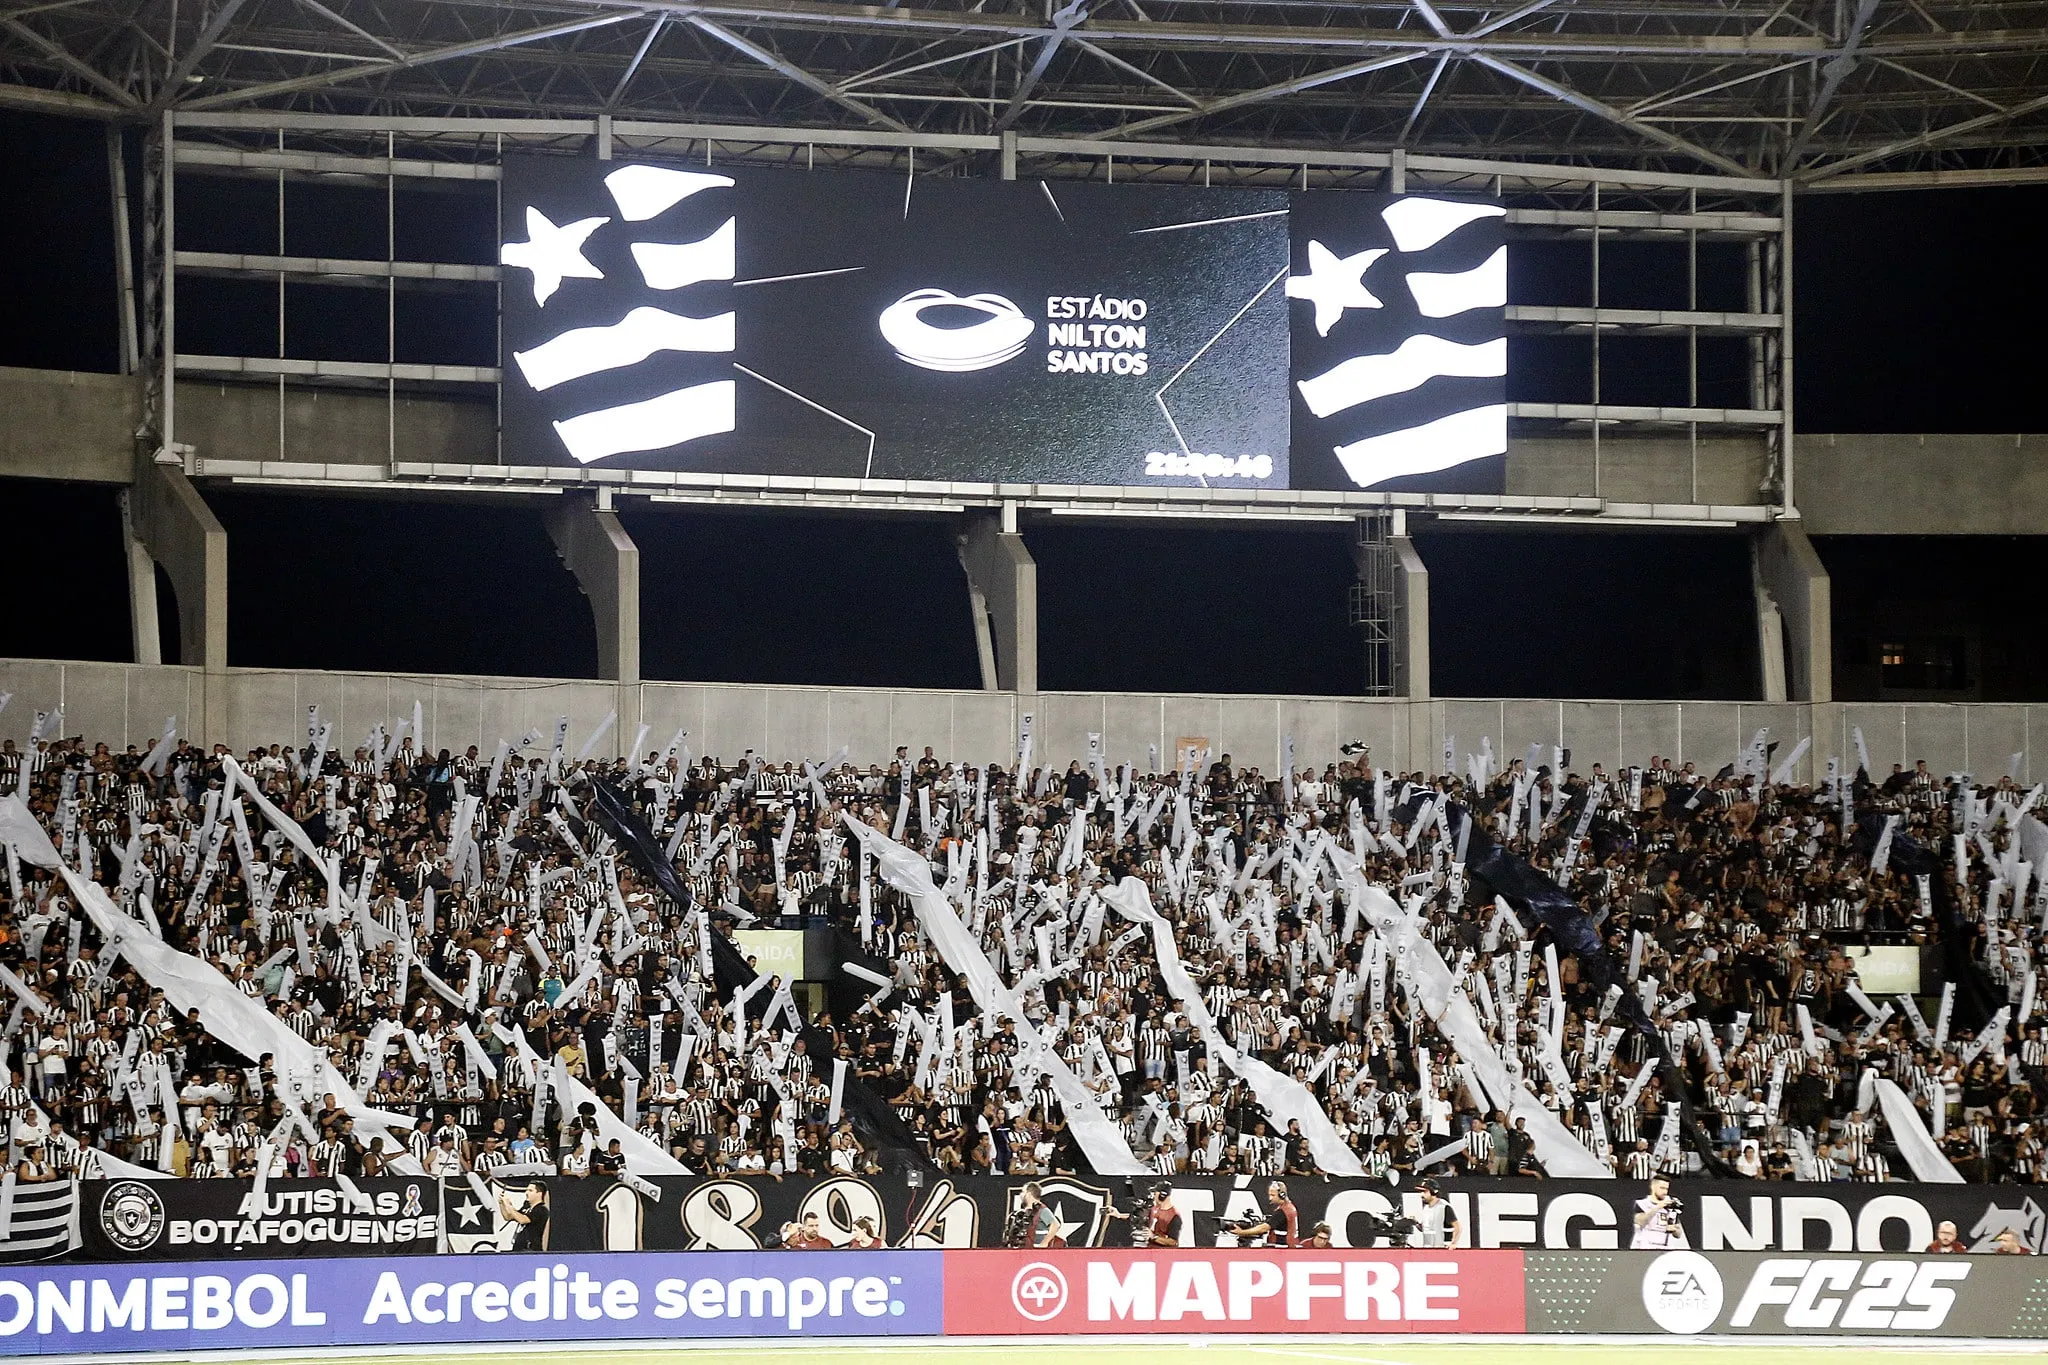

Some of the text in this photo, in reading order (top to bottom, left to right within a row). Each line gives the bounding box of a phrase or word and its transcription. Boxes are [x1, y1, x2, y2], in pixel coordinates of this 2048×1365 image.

[1047, 293, 1148, 321] ESTÁDIO
[1048, 323, 1147, 349] NILTON
[1047, 350, 1149, 376] SANTOS
[169, 1214, 438, 1245] BOTAFOGUENSE
[363, 1264, 639, 1325] Acredite
[1087, 1261, 1460, 1321] MAPFRE
[1660, 1271, 1706, 1295] EA
